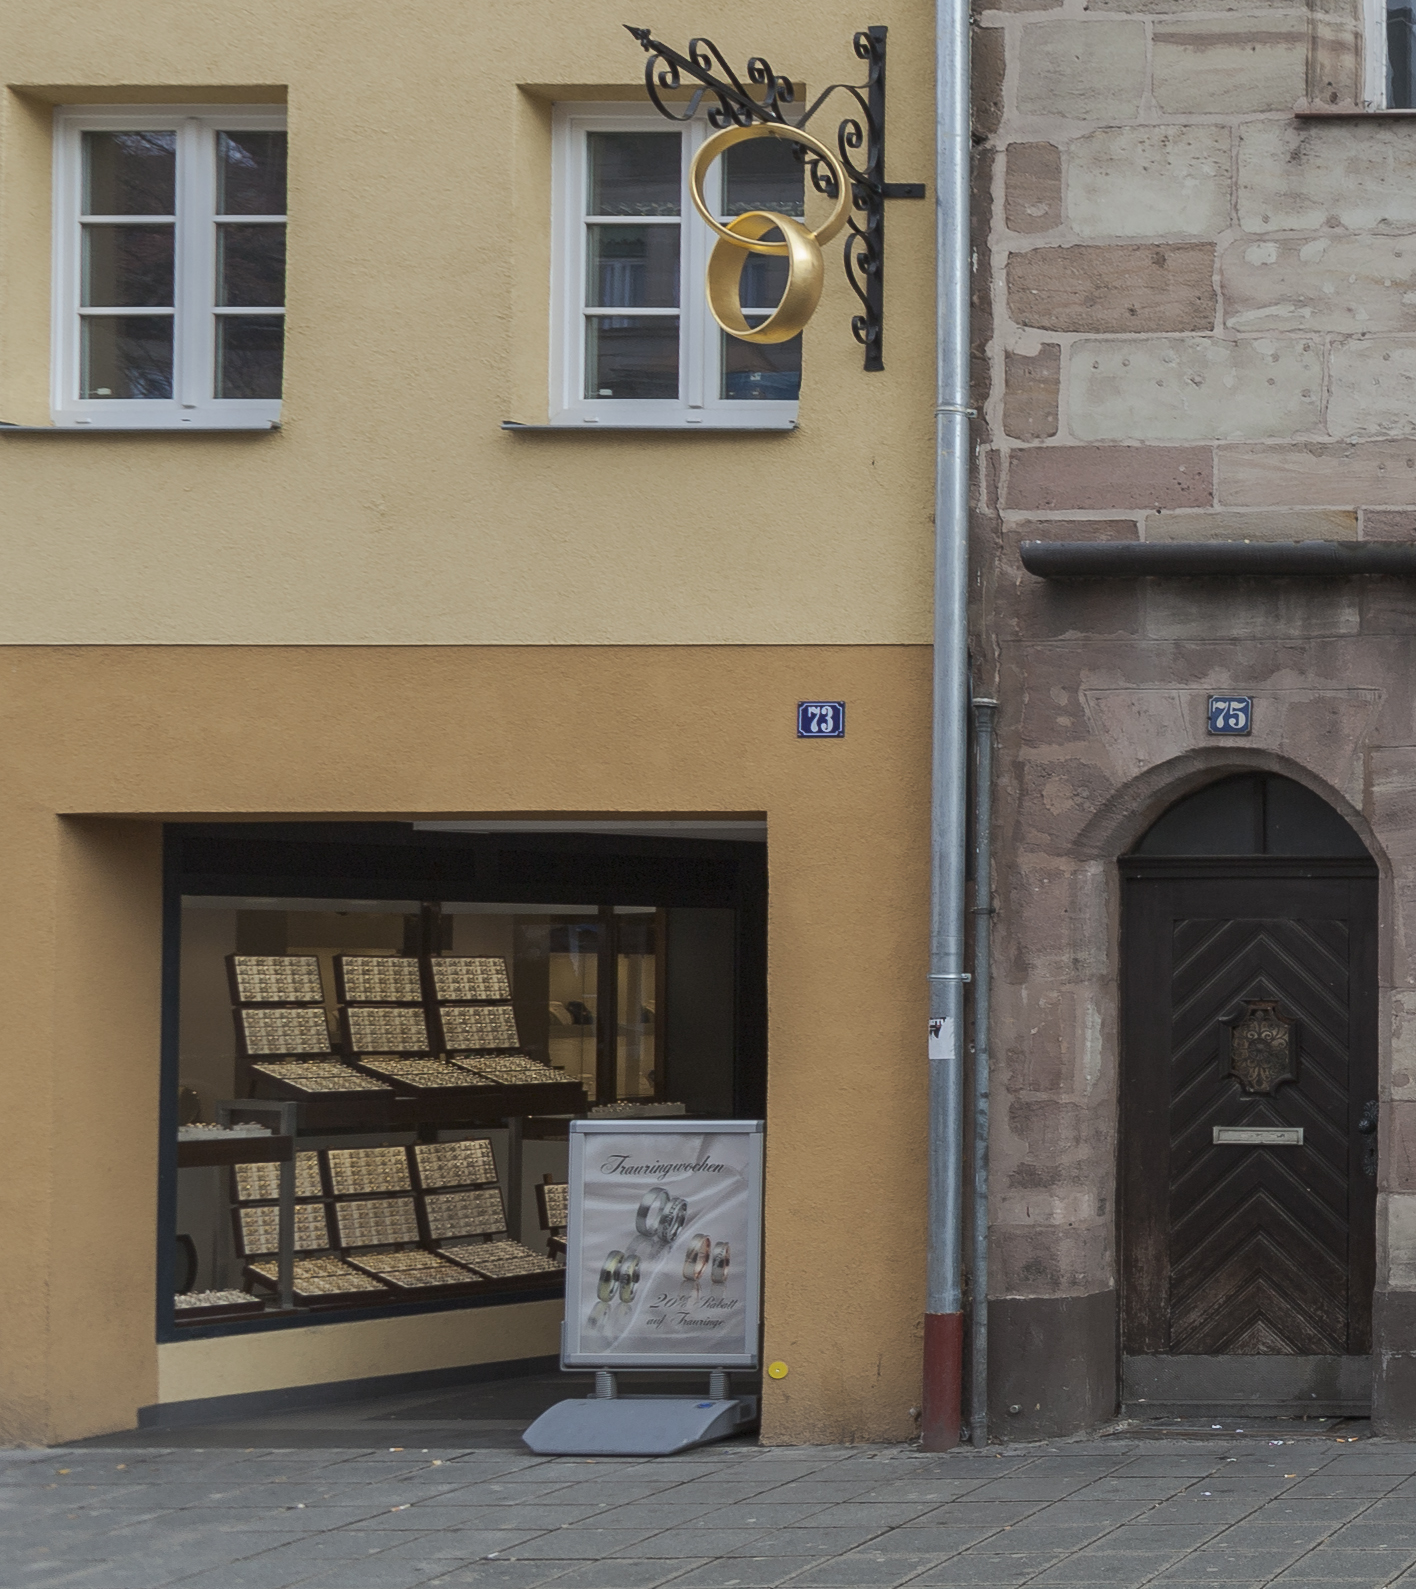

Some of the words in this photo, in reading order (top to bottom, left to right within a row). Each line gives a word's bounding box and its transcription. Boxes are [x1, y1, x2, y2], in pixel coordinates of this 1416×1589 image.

[807, 705, 834, 733] 73
[1212, 700, 1247, 729] 75
[600, 1154, 726, 1181] Trauringwochen
[649, 1293, 693, 1309] 20%
[700, 1295, 738, 1310] Rabatt
[646, 1314, 667, 1329] auf
[670, 1311, 726, 1329] Trauringe
